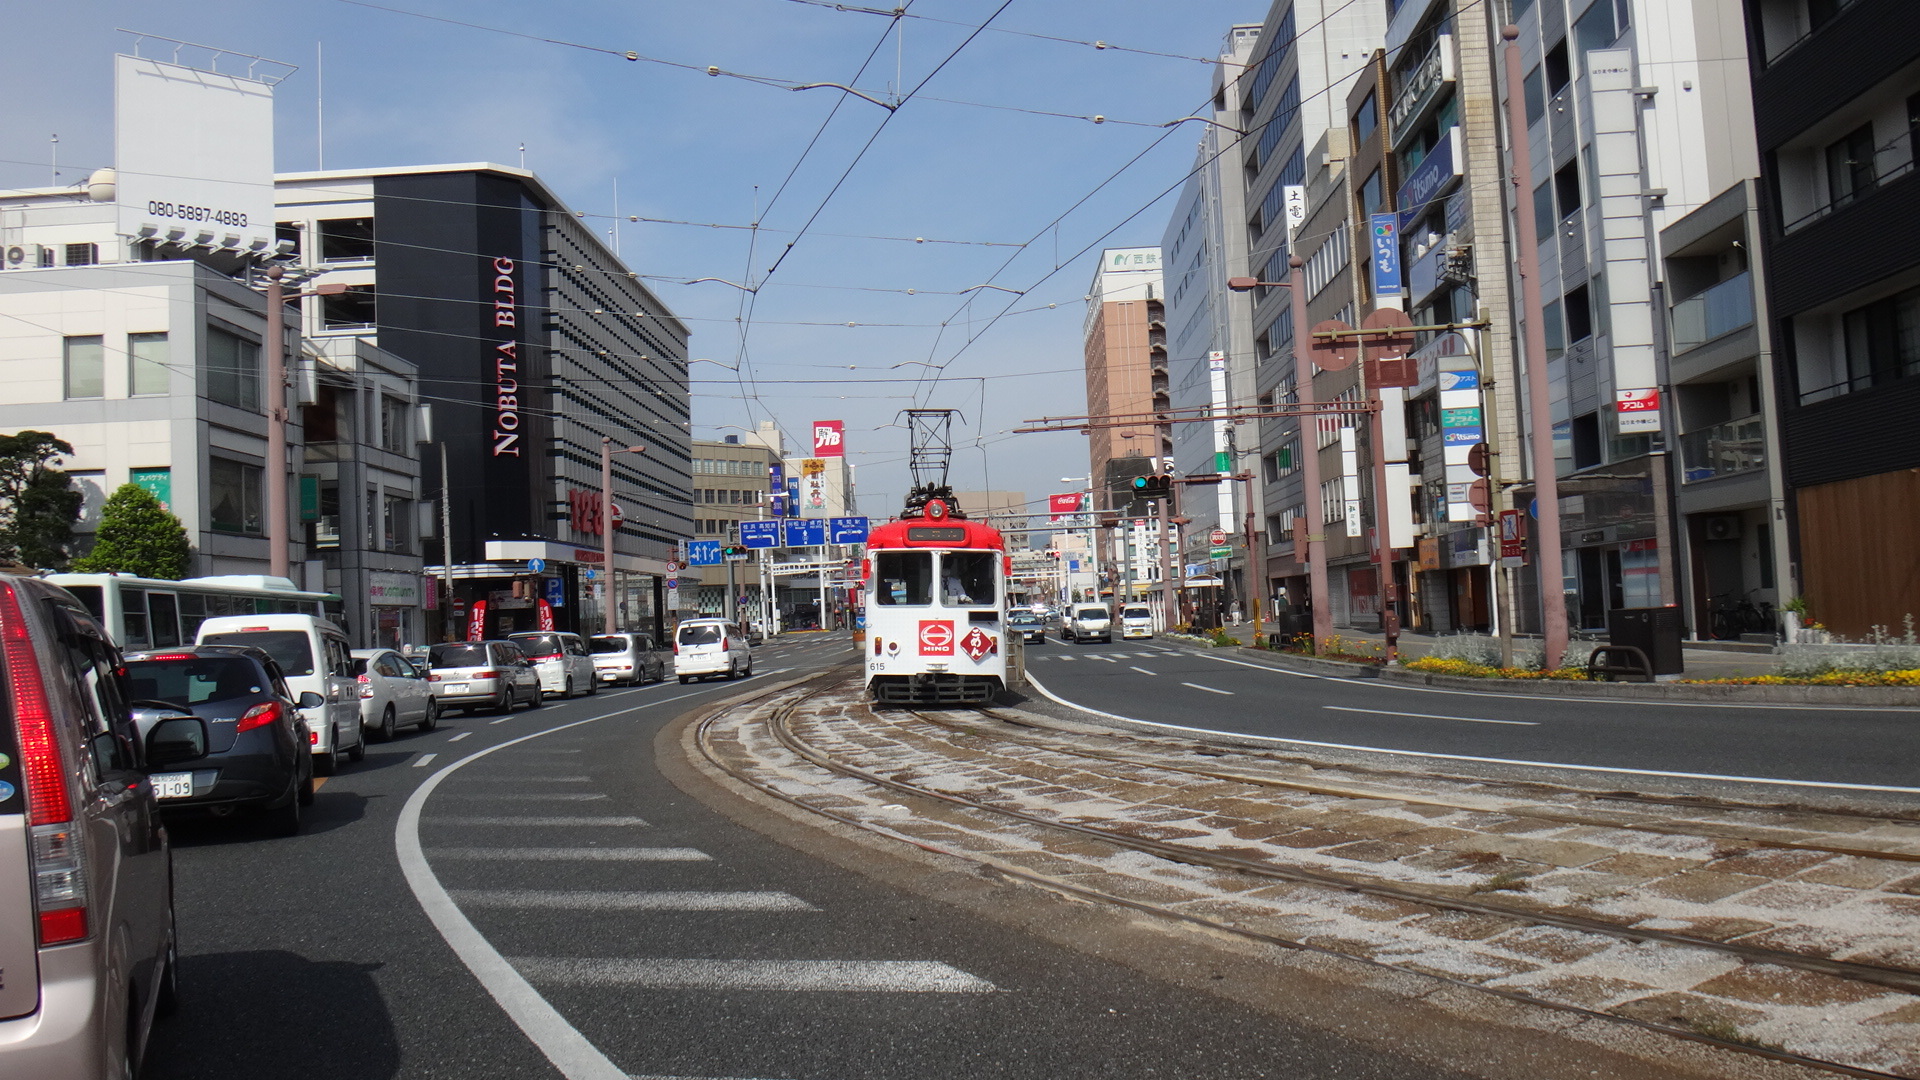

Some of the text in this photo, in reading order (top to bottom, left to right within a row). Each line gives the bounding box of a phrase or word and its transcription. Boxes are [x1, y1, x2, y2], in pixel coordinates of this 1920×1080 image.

[1413, 165, 1439, 203] itsumo
[148, 200, 248, 228] 080-5897-4893
[1377, 238, 1393, 273] いつも
[493, 256, 519, 457] NOBUTA BLDG
[1622, 401, 1645, 410] アコム
[548, 579, 560, 592] P
[970, 627, 983, 658] ごめん
[870, 663, 885, 671] 615
